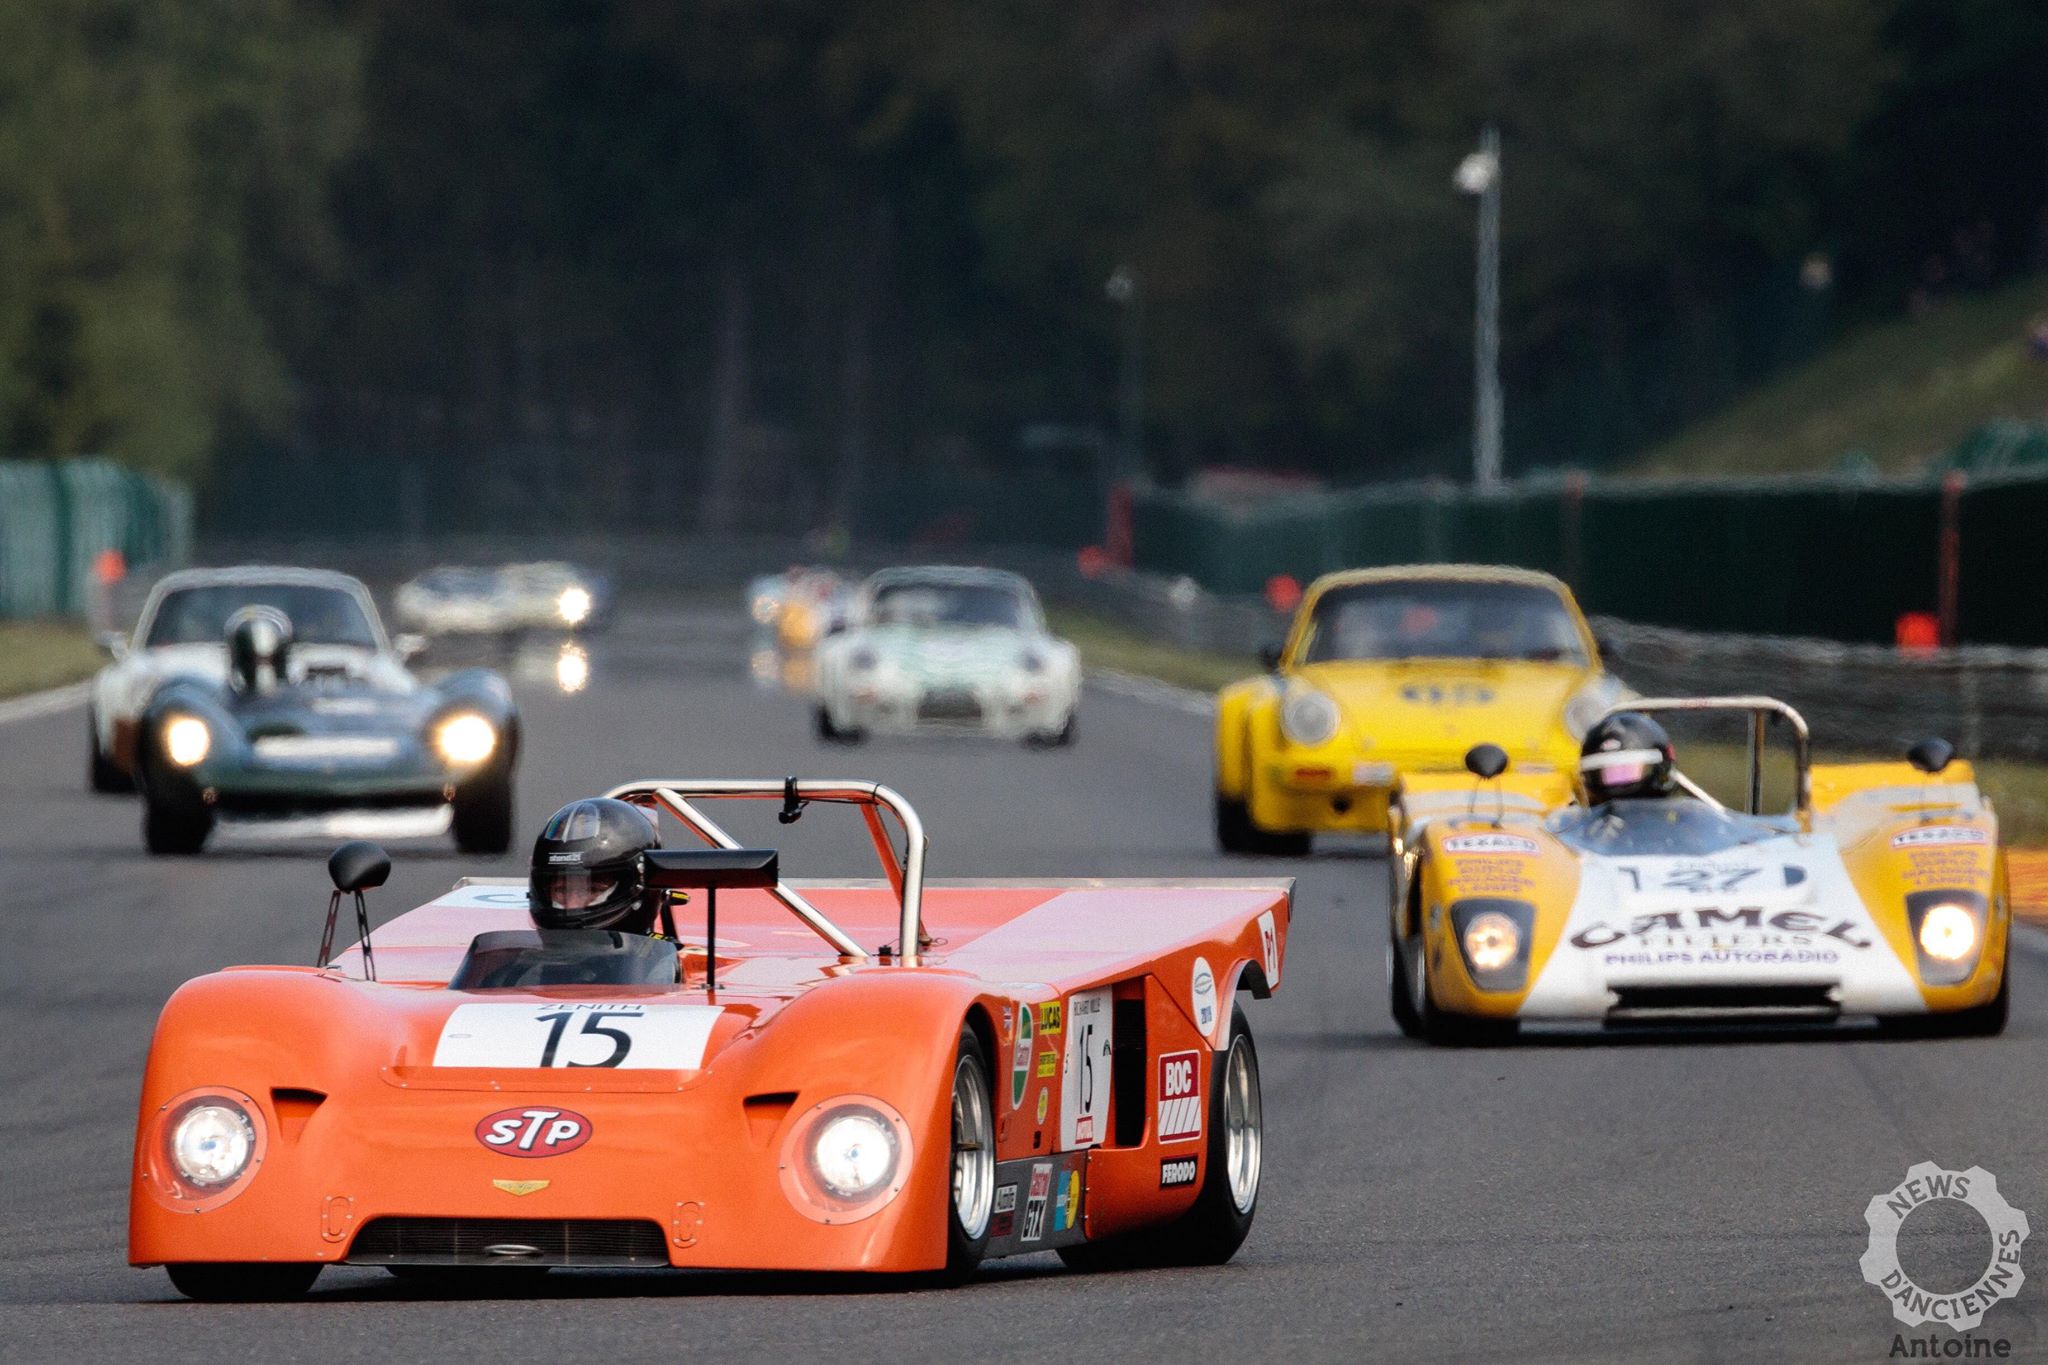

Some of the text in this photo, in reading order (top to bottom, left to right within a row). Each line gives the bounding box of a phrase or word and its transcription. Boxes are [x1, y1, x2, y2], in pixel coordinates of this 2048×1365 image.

[1570, 907, 1872, 949] CAMEL
[1605, 950, 1839, 965] PHILIPS AUTORADIO
[534, 1011, 644, 1069] 15
[1078, 1024, 1093, 1115] 15
[1164, 1060, 1193, 1097] BOC
[485, 1110, 582, 1151] STP
[1161, 1160, 1197, 1184] FERODO
